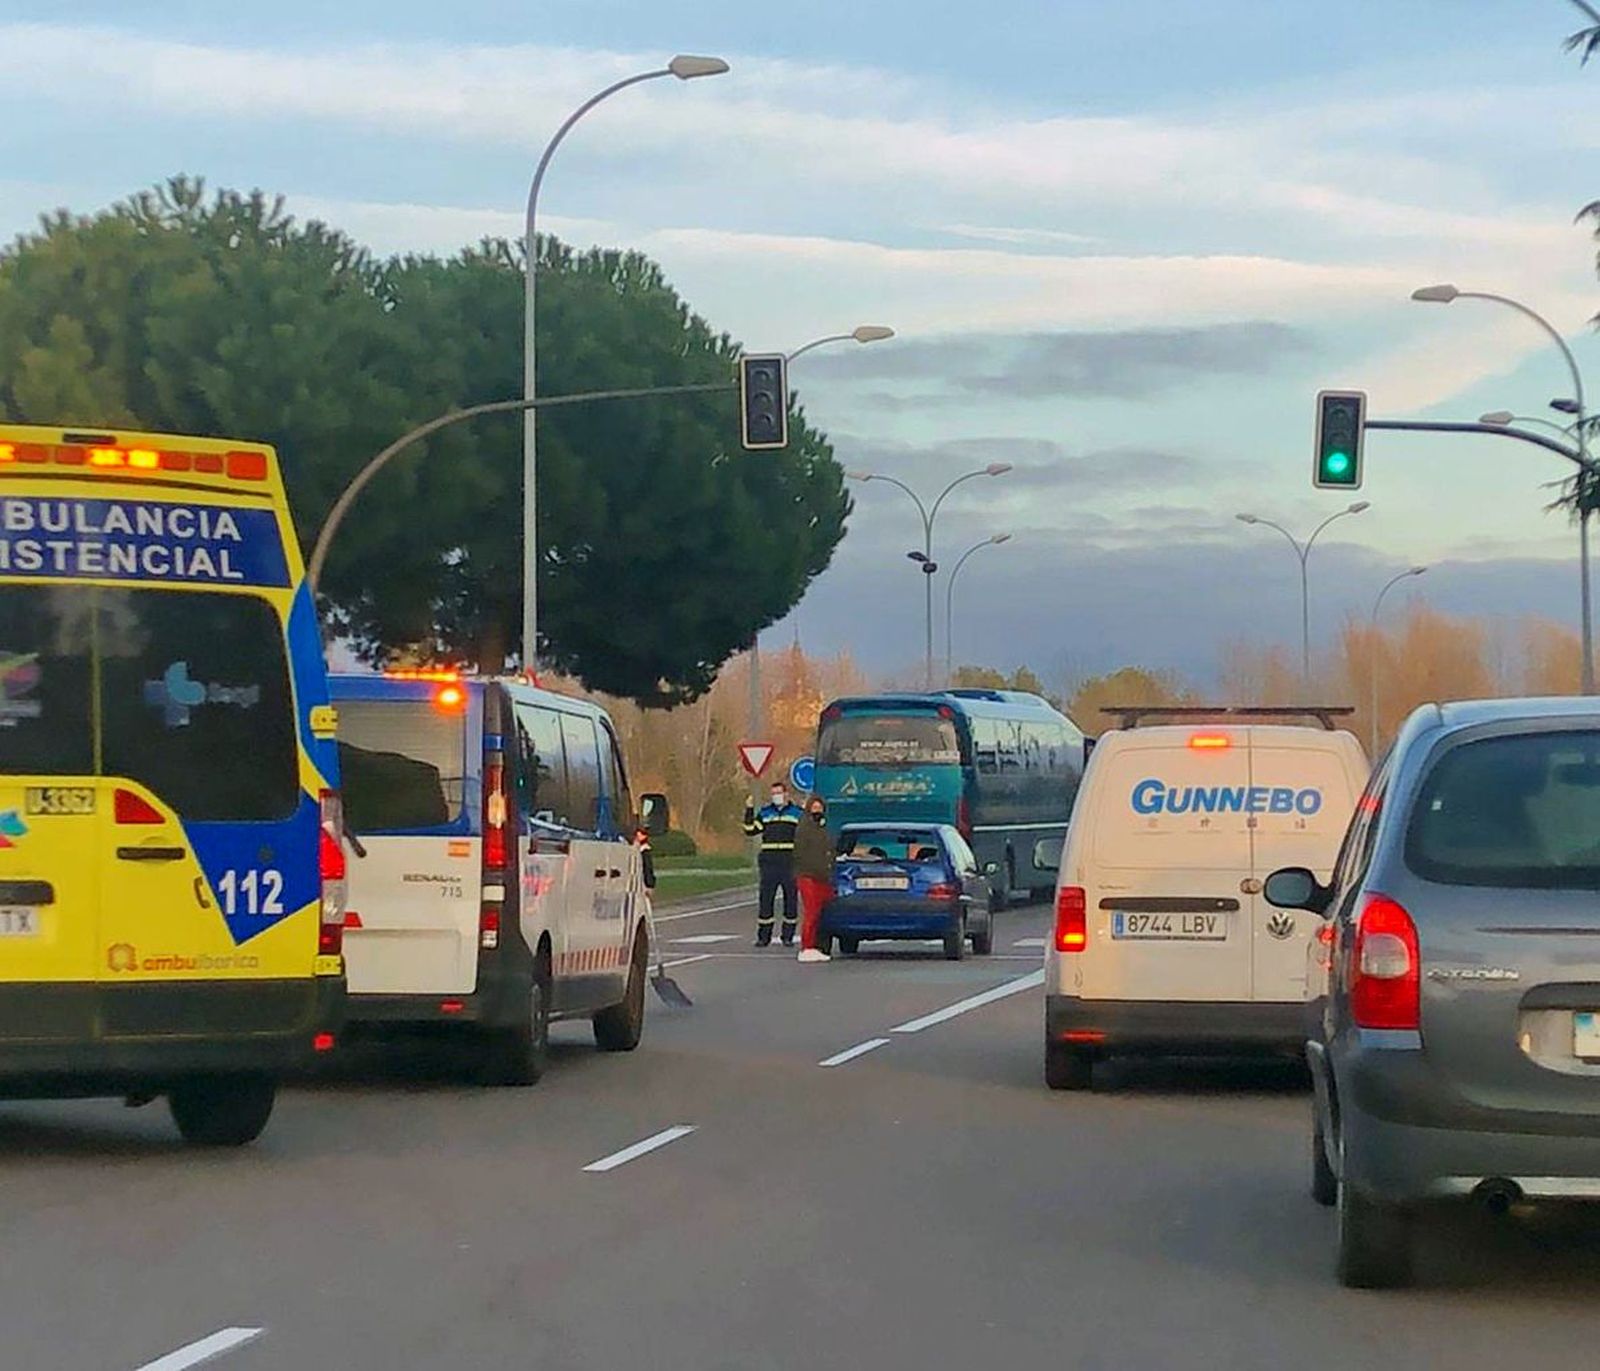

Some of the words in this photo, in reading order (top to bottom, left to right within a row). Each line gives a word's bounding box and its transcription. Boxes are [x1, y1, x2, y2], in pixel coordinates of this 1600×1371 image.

[1131, 778, 1322, 815] GUNNEBO
[218, 869, 284, 915] 112
[1127, 914, 1173, 934] 8744
[1181, 915, 1217, 934] LBV
